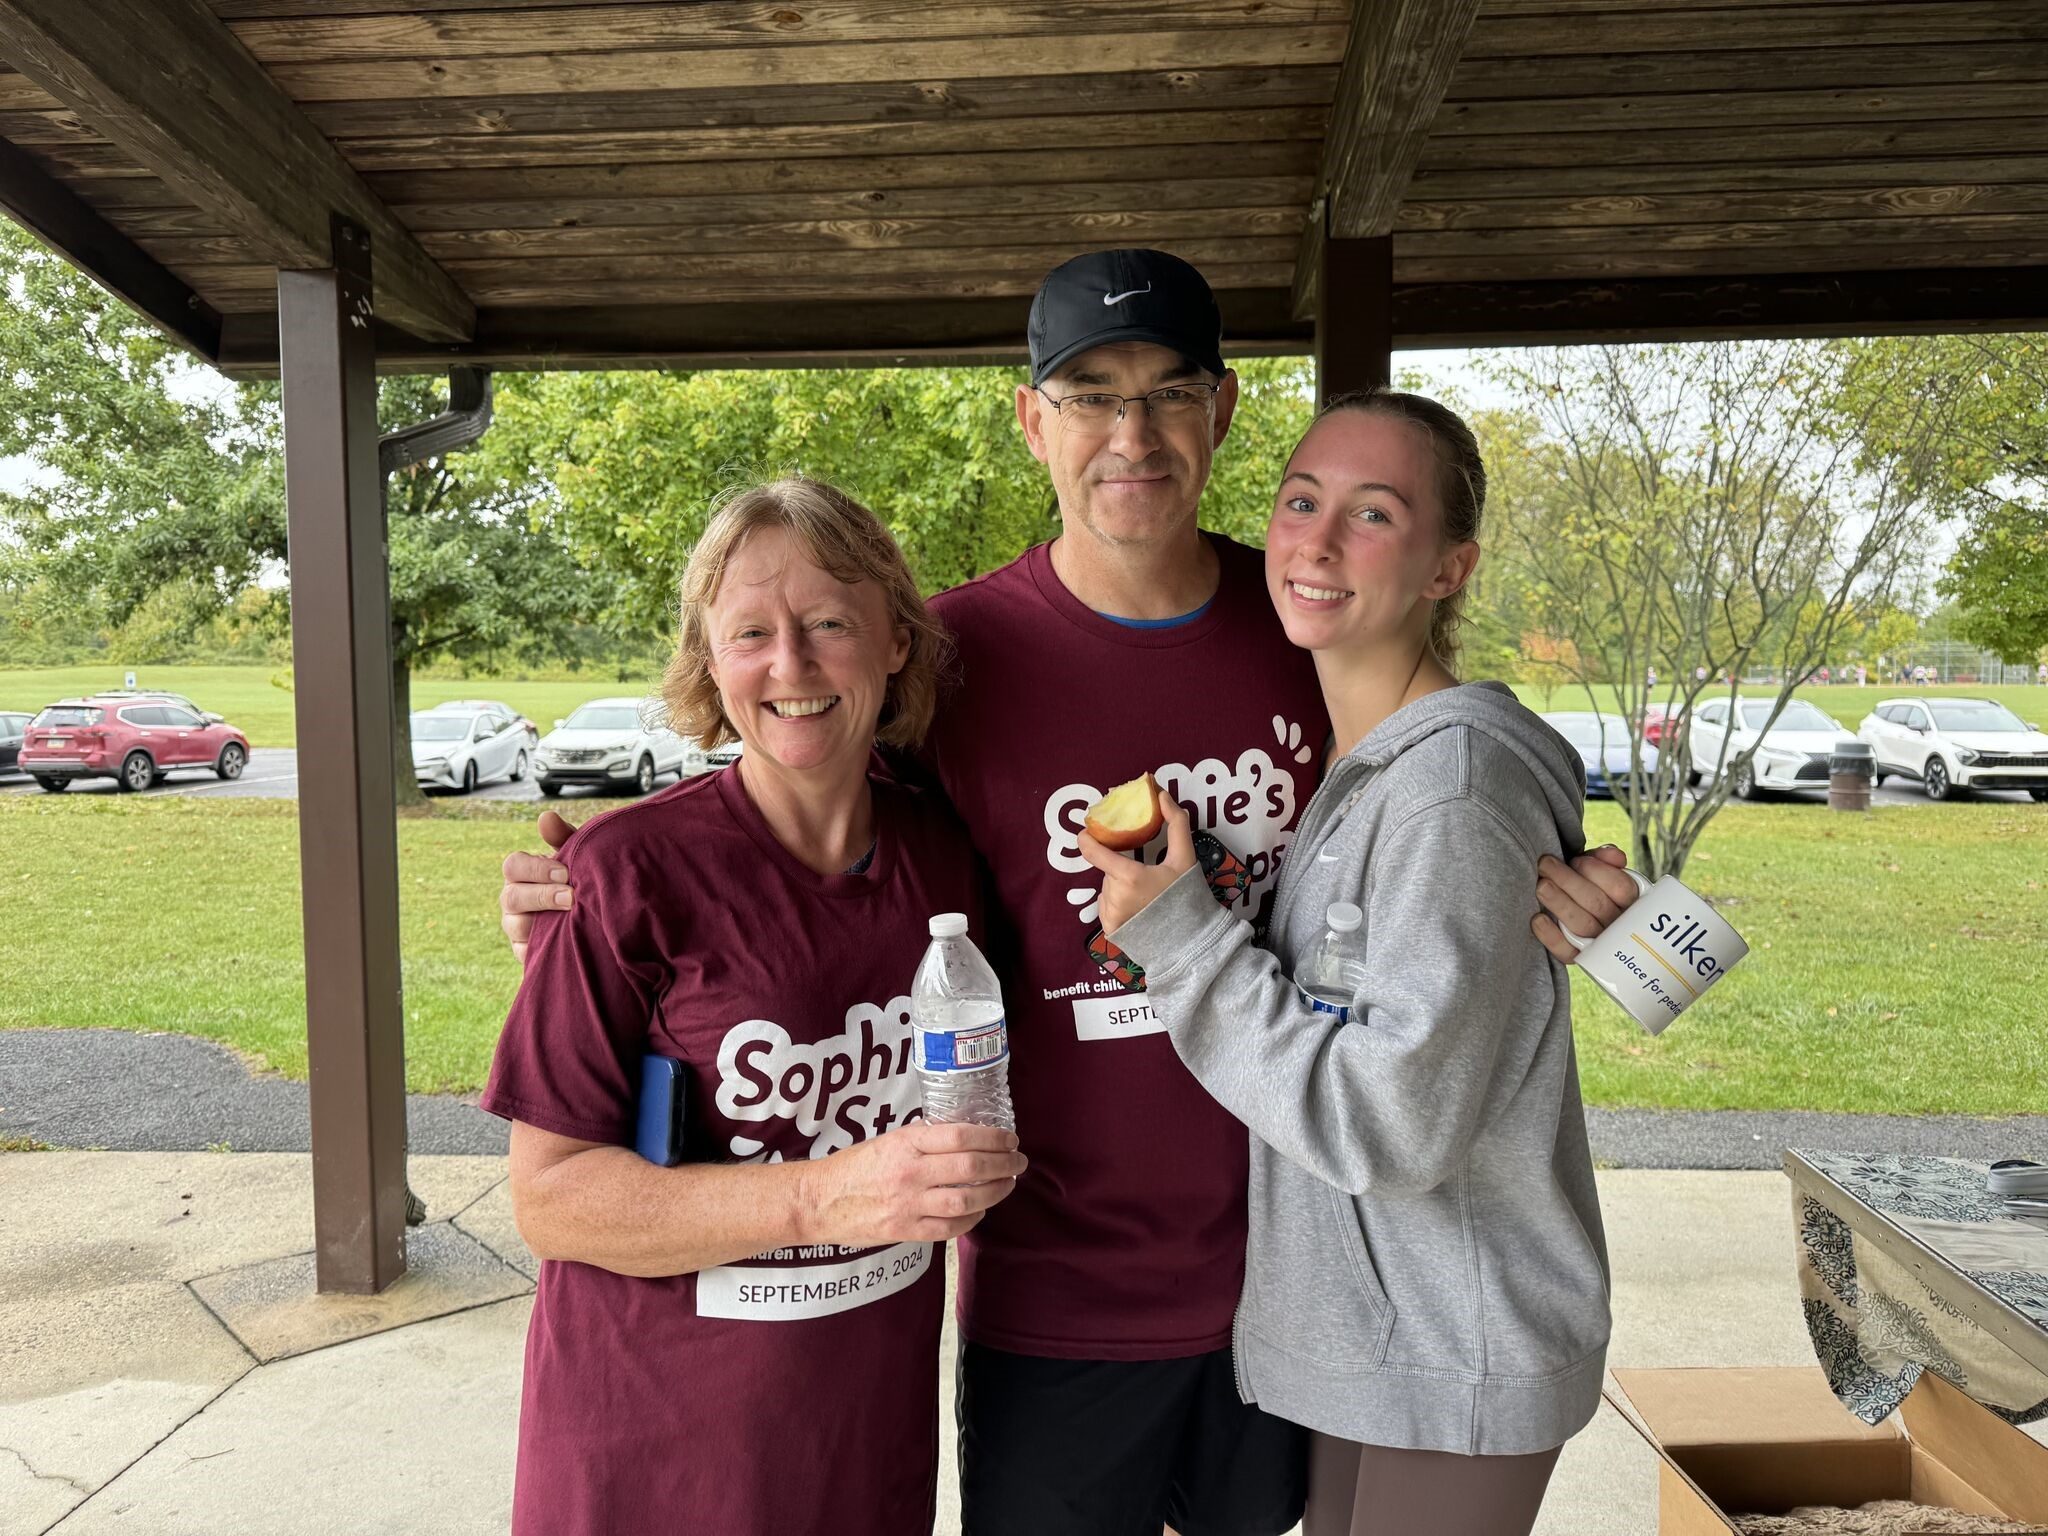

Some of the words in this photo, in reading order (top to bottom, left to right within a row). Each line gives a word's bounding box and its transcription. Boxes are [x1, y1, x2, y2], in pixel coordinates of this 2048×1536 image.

[1058, 763, 1284, 859] Shie's
[1043, 982, 1091, 1000] benefit
[1614, 949, 1647, 980] solace
[1642, 978, 1664, 995] for
[732, 1010, 911, 1121] Sophi
[738, 1275, 860, 1304] SEPTEMBER
[864, 1266, 888, 1288] 29,
[892, 1246, 924, 1278] 2024
[798, 1244, 834, 1259] with
